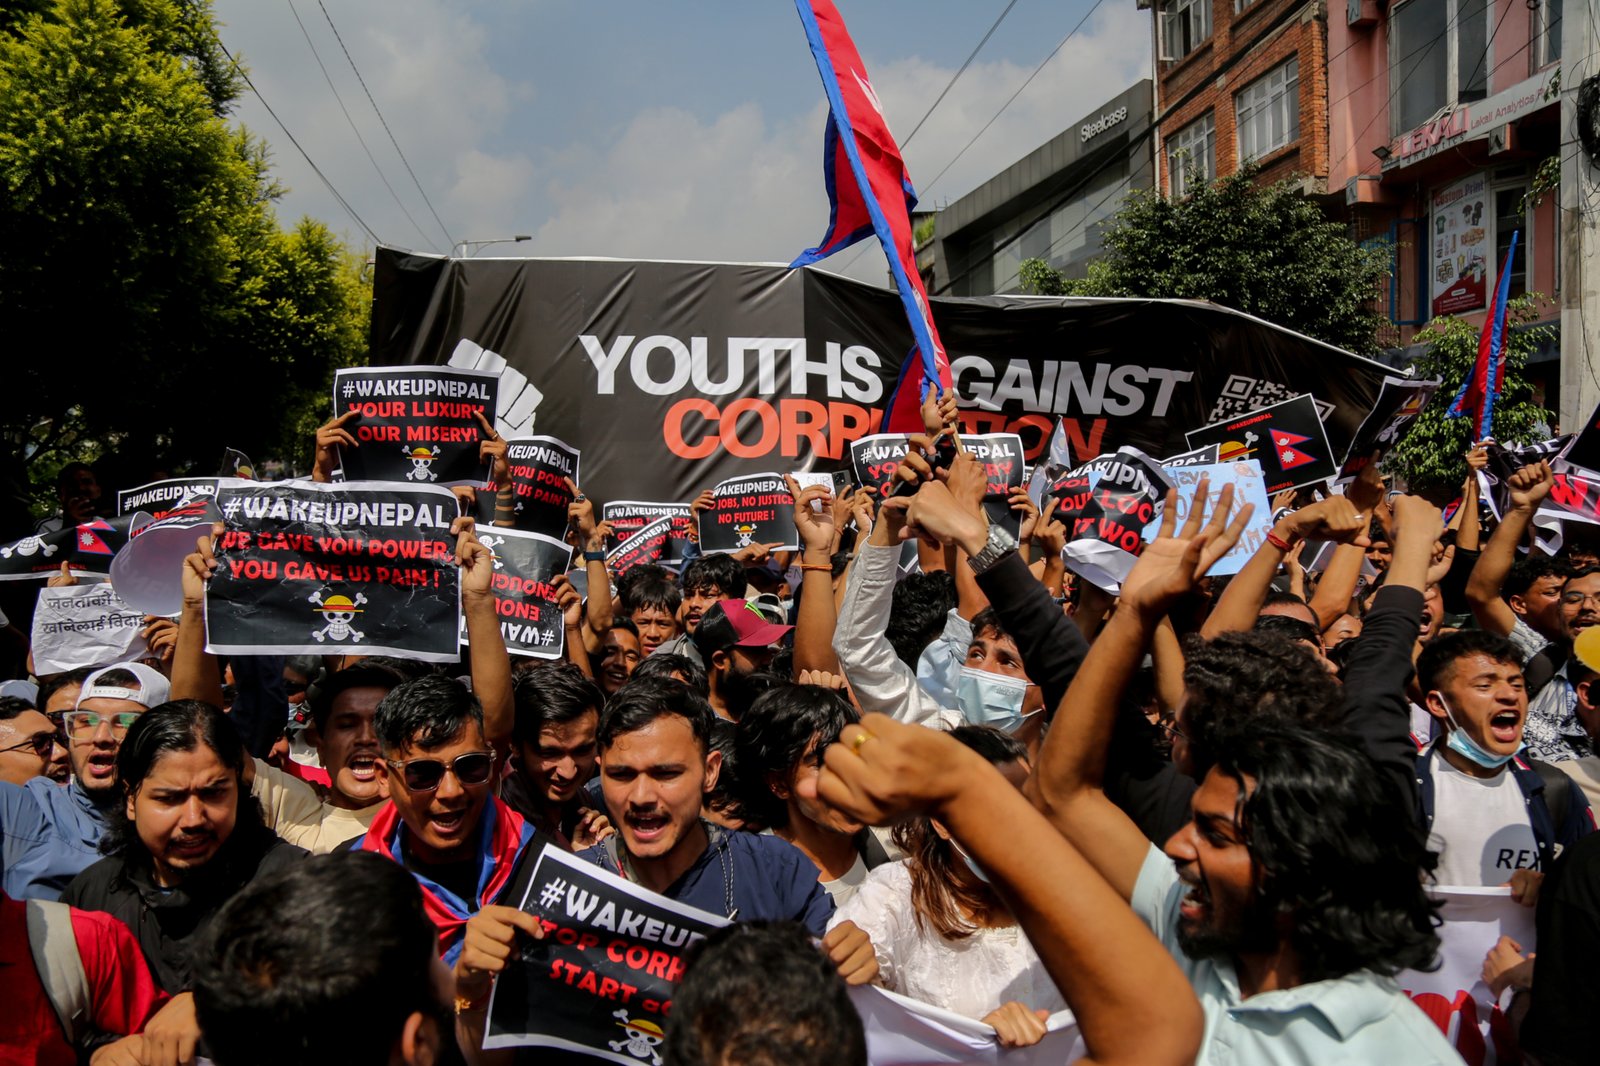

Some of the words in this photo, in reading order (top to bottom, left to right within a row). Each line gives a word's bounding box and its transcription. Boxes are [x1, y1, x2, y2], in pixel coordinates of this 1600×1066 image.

[1495, 95, 1535, 119] Analytics
[1081, 106, 1127, 142] Steelcase
[1401, 106, 1470, 159] LEKALI
[1406, 135, 1465, 164] analytics
[342, 379, 490, 400] #WAKEUPNEPAL
[578, 335, 884, 403] YOUTHS
[950, 355, 1194, 417] GAINST
[349, 402, 406, 418] YOUR
[412, 403, 485, 420] LUXURY
[357, 426, 400, 442] OUR
[407, 426, 478, 442] MISERY!
[507, 444, 572, 474] KEUPNEPAL
[514, 466, 535, 479] YOU
[517, 484, 533, 497] US
[534, 491, 562, 506] PAIN
[718, 497, 740, 510] JOBS,
[742, 497, 757, 507] NO
[758, 494, 793, 505] JUSTICE
[224, 497, 449, 528] #WAKEUPNEPAL
[608, 507, 691, 518] #WAKEUPNEPAL
[718, 513, 732, 524] NO
[734, 511, 768, 522] FUTURE
[257, 533, 314, 552] GAVE
[319, 537, 361, 556] YOU
[369, 539, 453, 562] POWER,
[230, 560, 277, 580] YOU
[284, 563, 343, 581] GAVE
[348, 564, 372, 582] US
[376, 566, 427, 586] PAIN
[491, 572, 557, 603] ENOUG
[532, 915, 599, 951] TOP
[550, 959, 637, 1004] START
